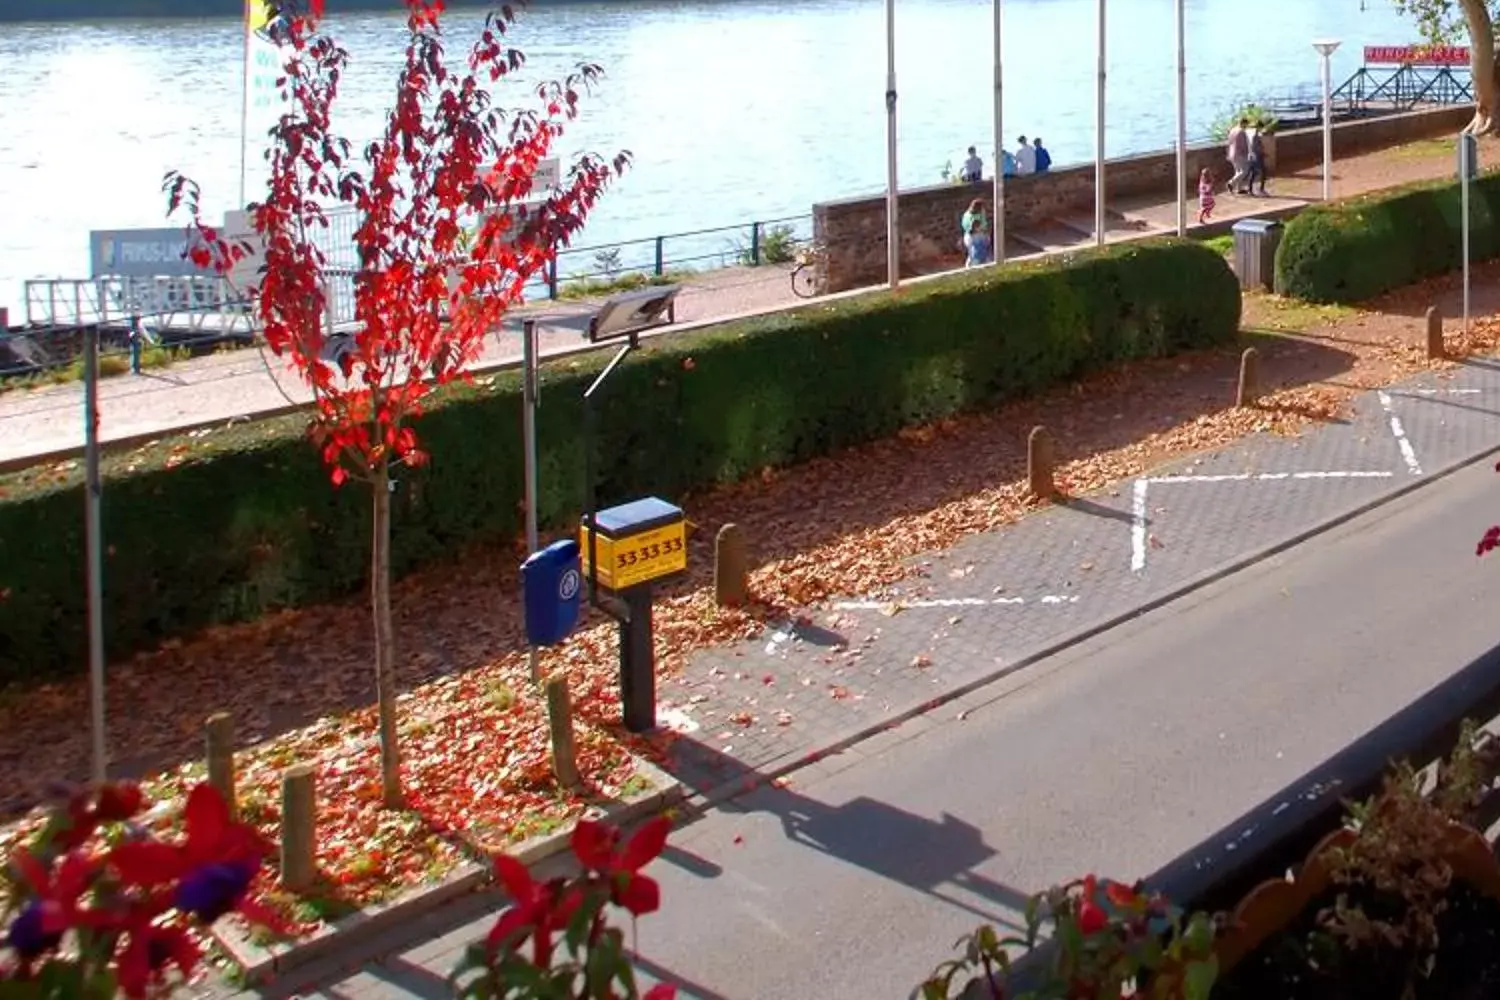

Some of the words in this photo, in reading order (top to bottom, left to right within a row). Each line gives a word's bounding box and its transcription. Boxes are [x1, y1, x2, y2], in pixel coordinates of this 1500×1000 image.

[617, 552, 638, 568] 33
[640, 544, 660, 560] 33
[662, 536, 683, 555] 33
